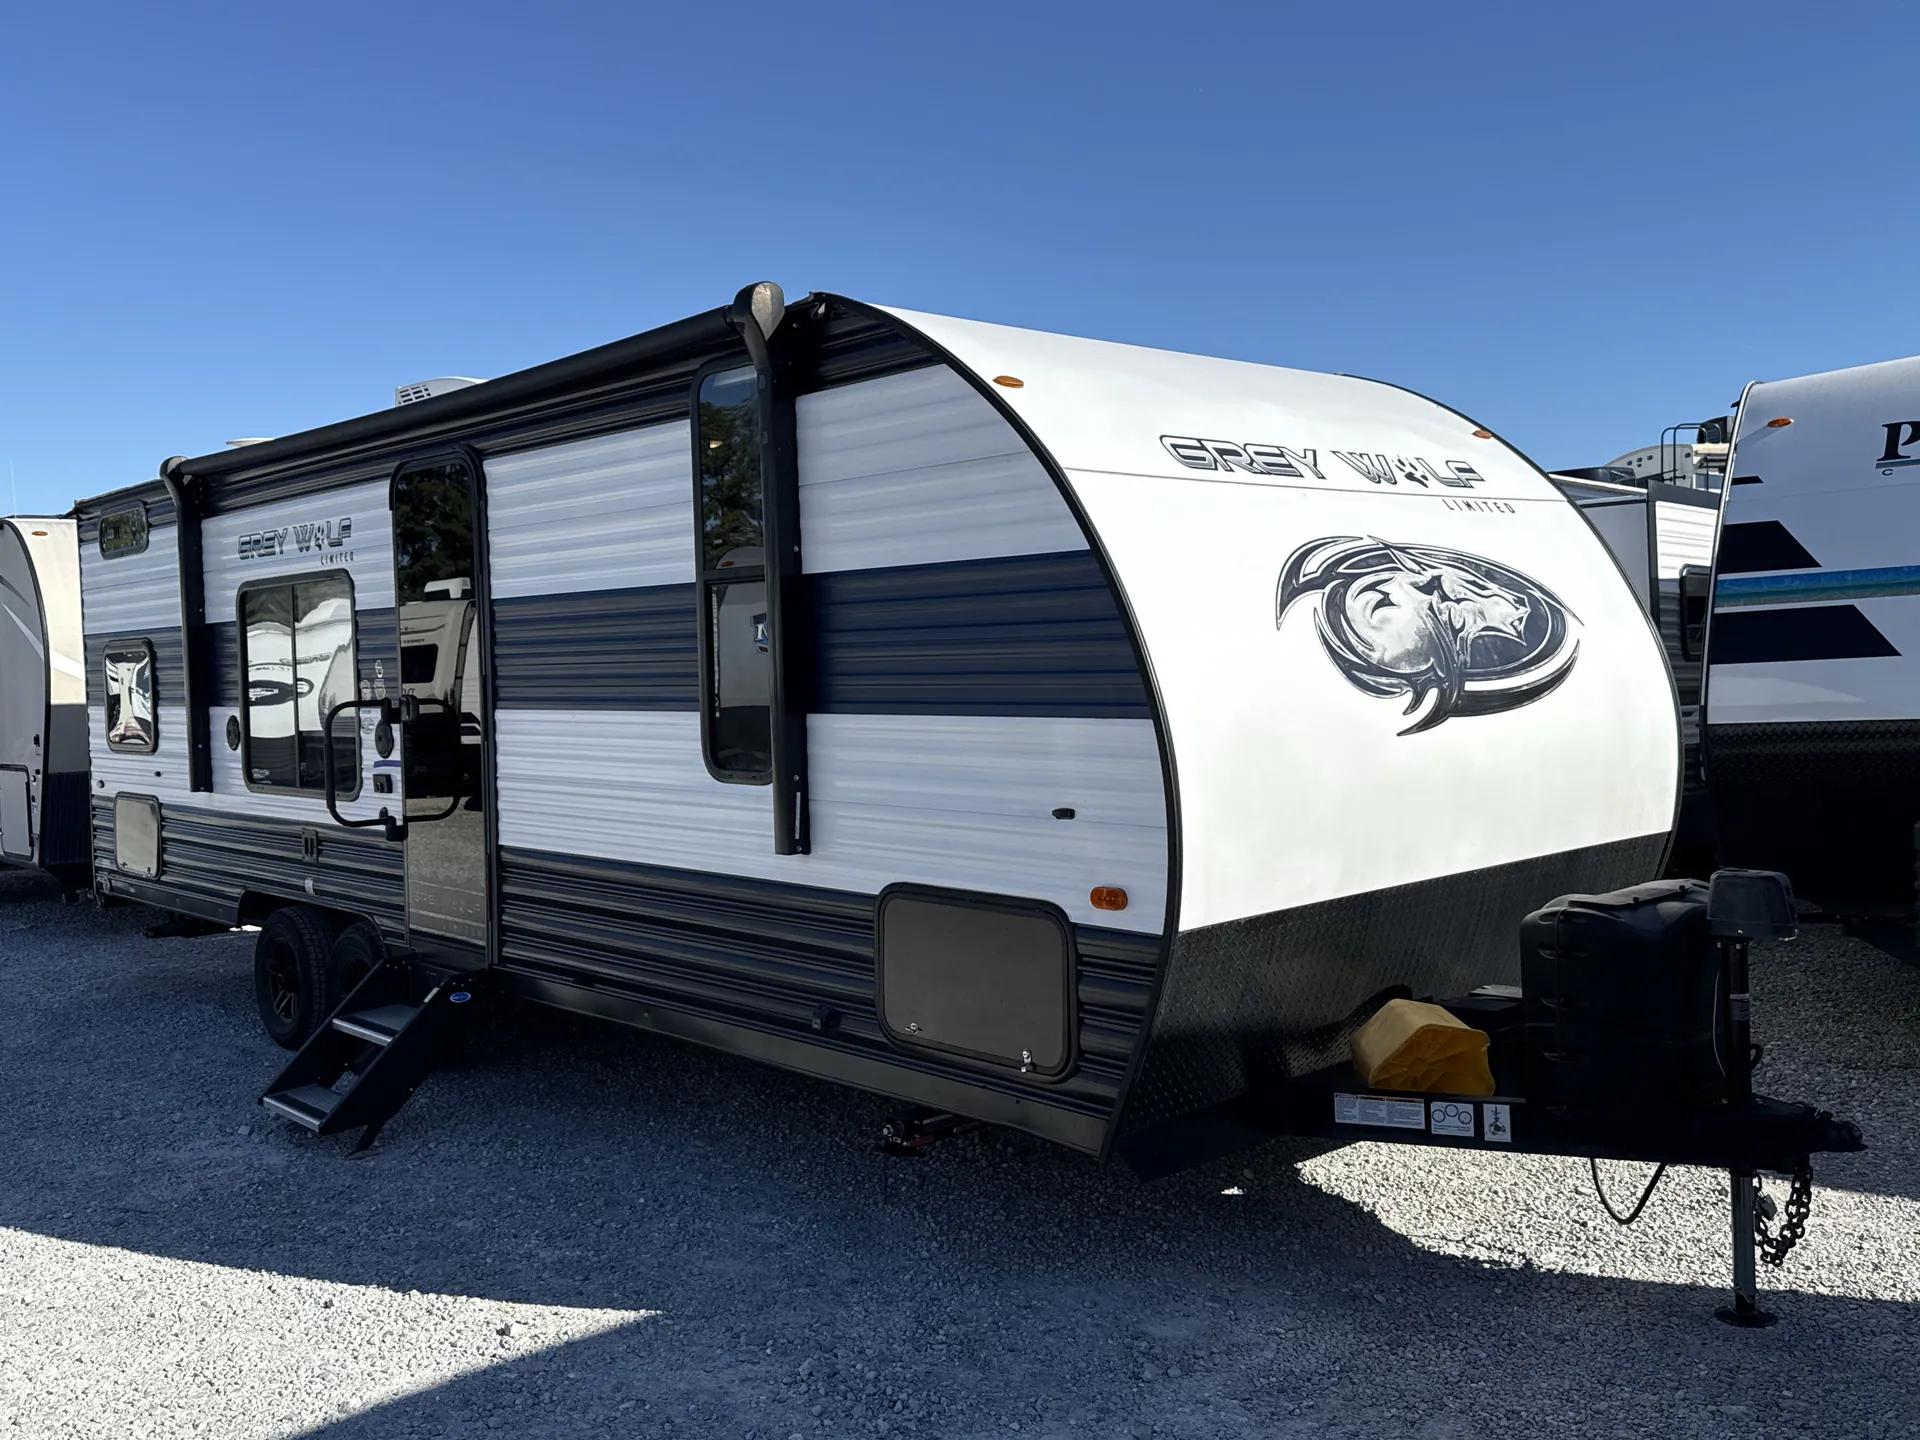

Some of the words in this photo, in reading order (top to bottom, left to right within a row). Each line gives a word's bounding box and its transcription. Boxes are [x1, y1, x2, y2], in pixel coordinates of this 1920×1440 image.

[1159, 434, 1328, 480] GREY
[1442, 498, 1516, 514] LIMITED
[238, 527, 288, 560] GREY
[320, 551, 354, 566] LIMITED
